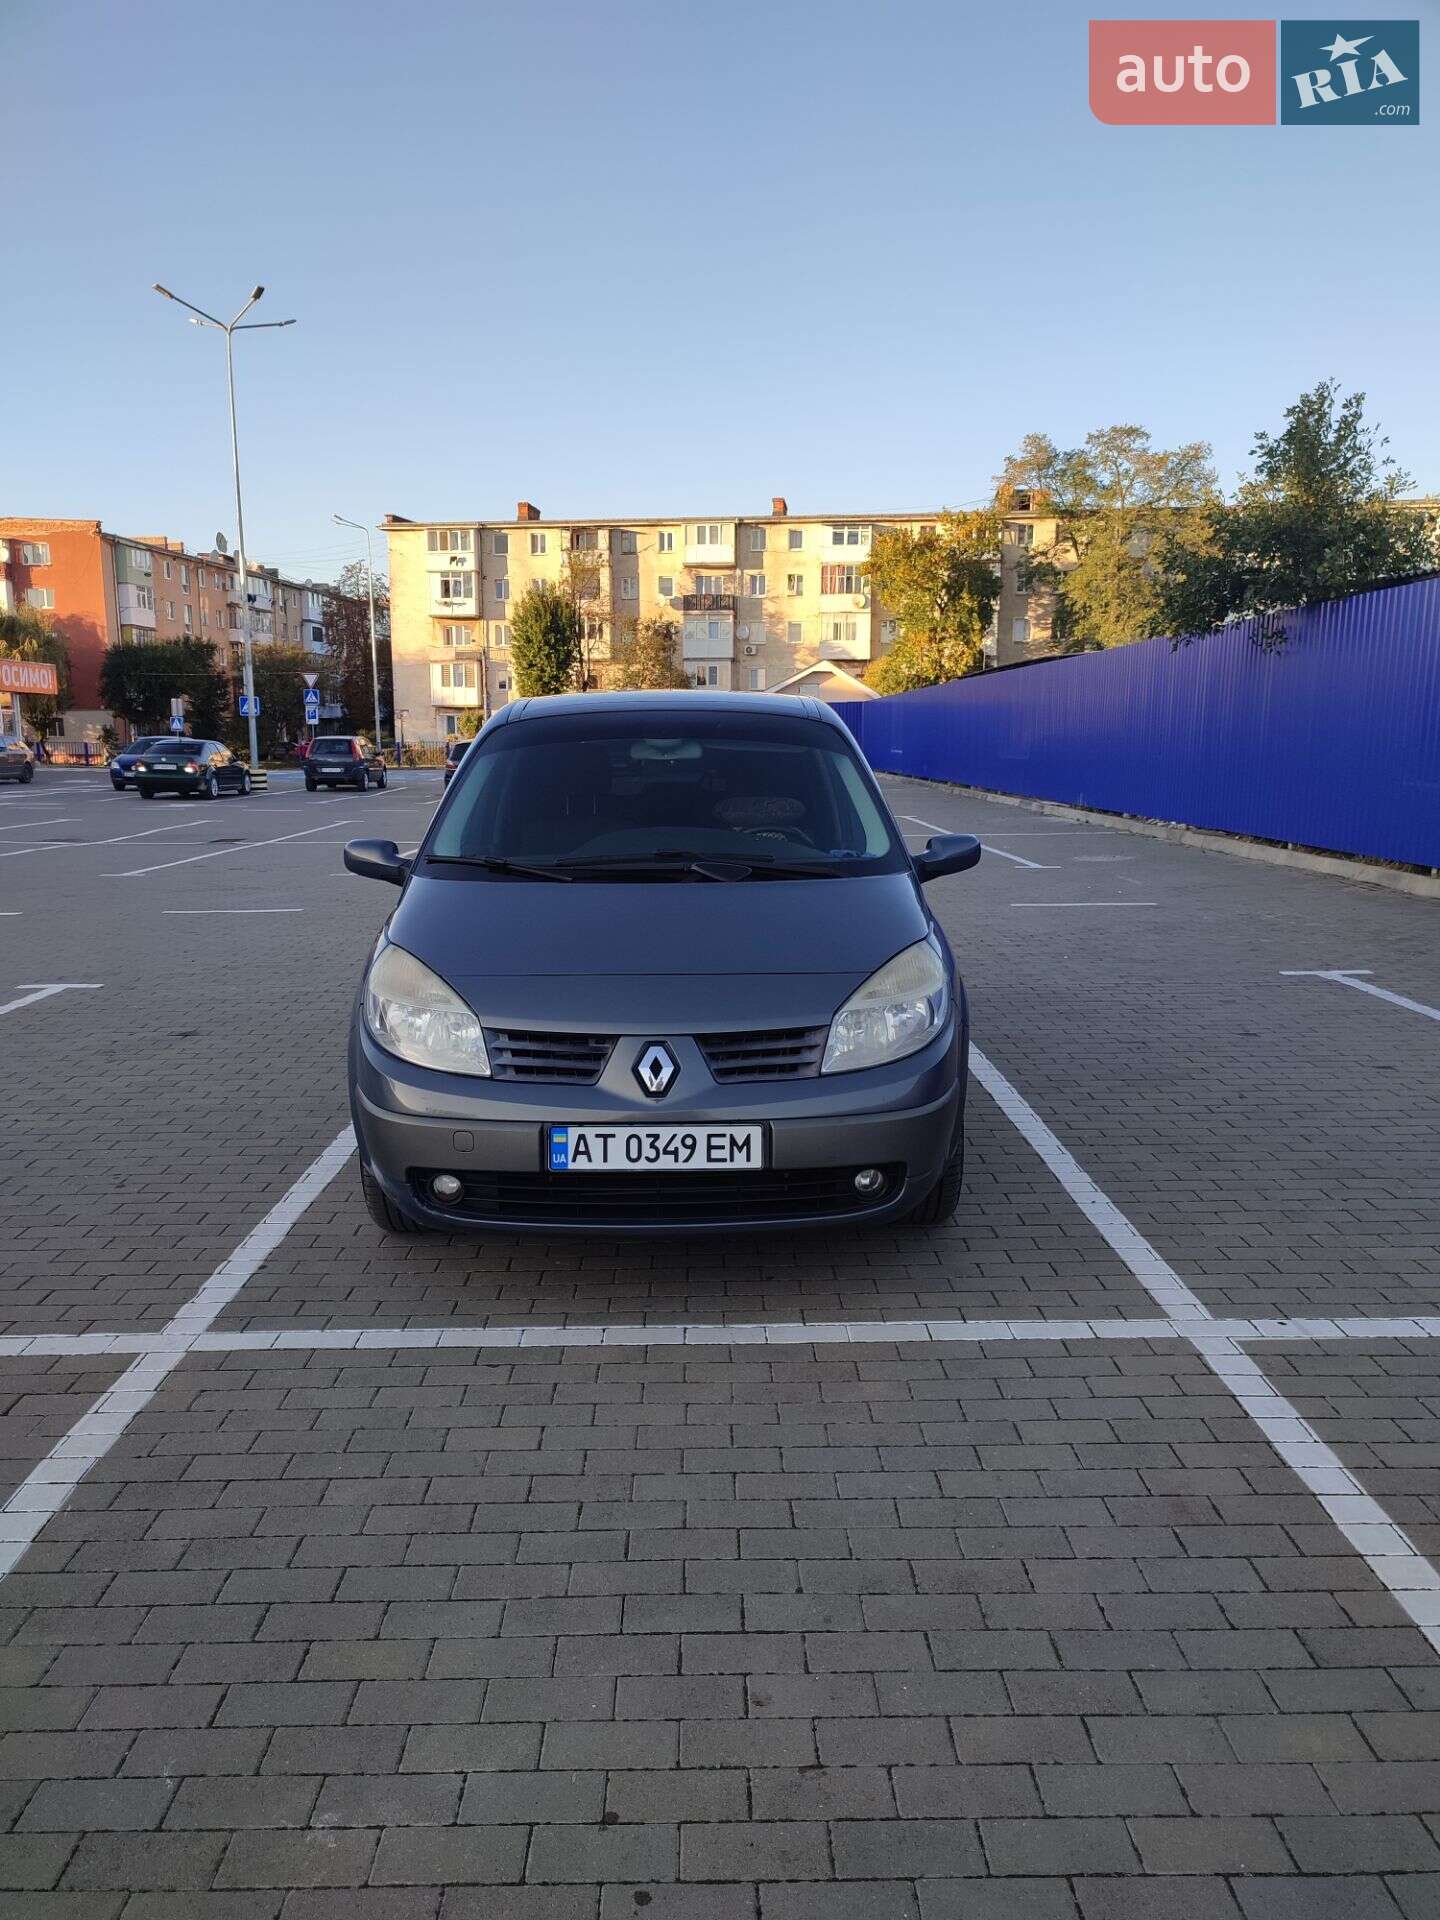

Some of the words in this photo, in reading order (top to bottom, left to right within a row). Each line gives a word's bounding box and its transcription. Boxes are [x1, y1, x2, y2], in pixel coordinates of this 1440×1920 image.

[0, 664, 53, 689] ОСИМО!
[553, 1154, 567, 1163] UA
[571, 1133, 616, 1163] AT
[625, 1133, 697, 1163] 0349
[706, 1133, 751, 1163] EM
